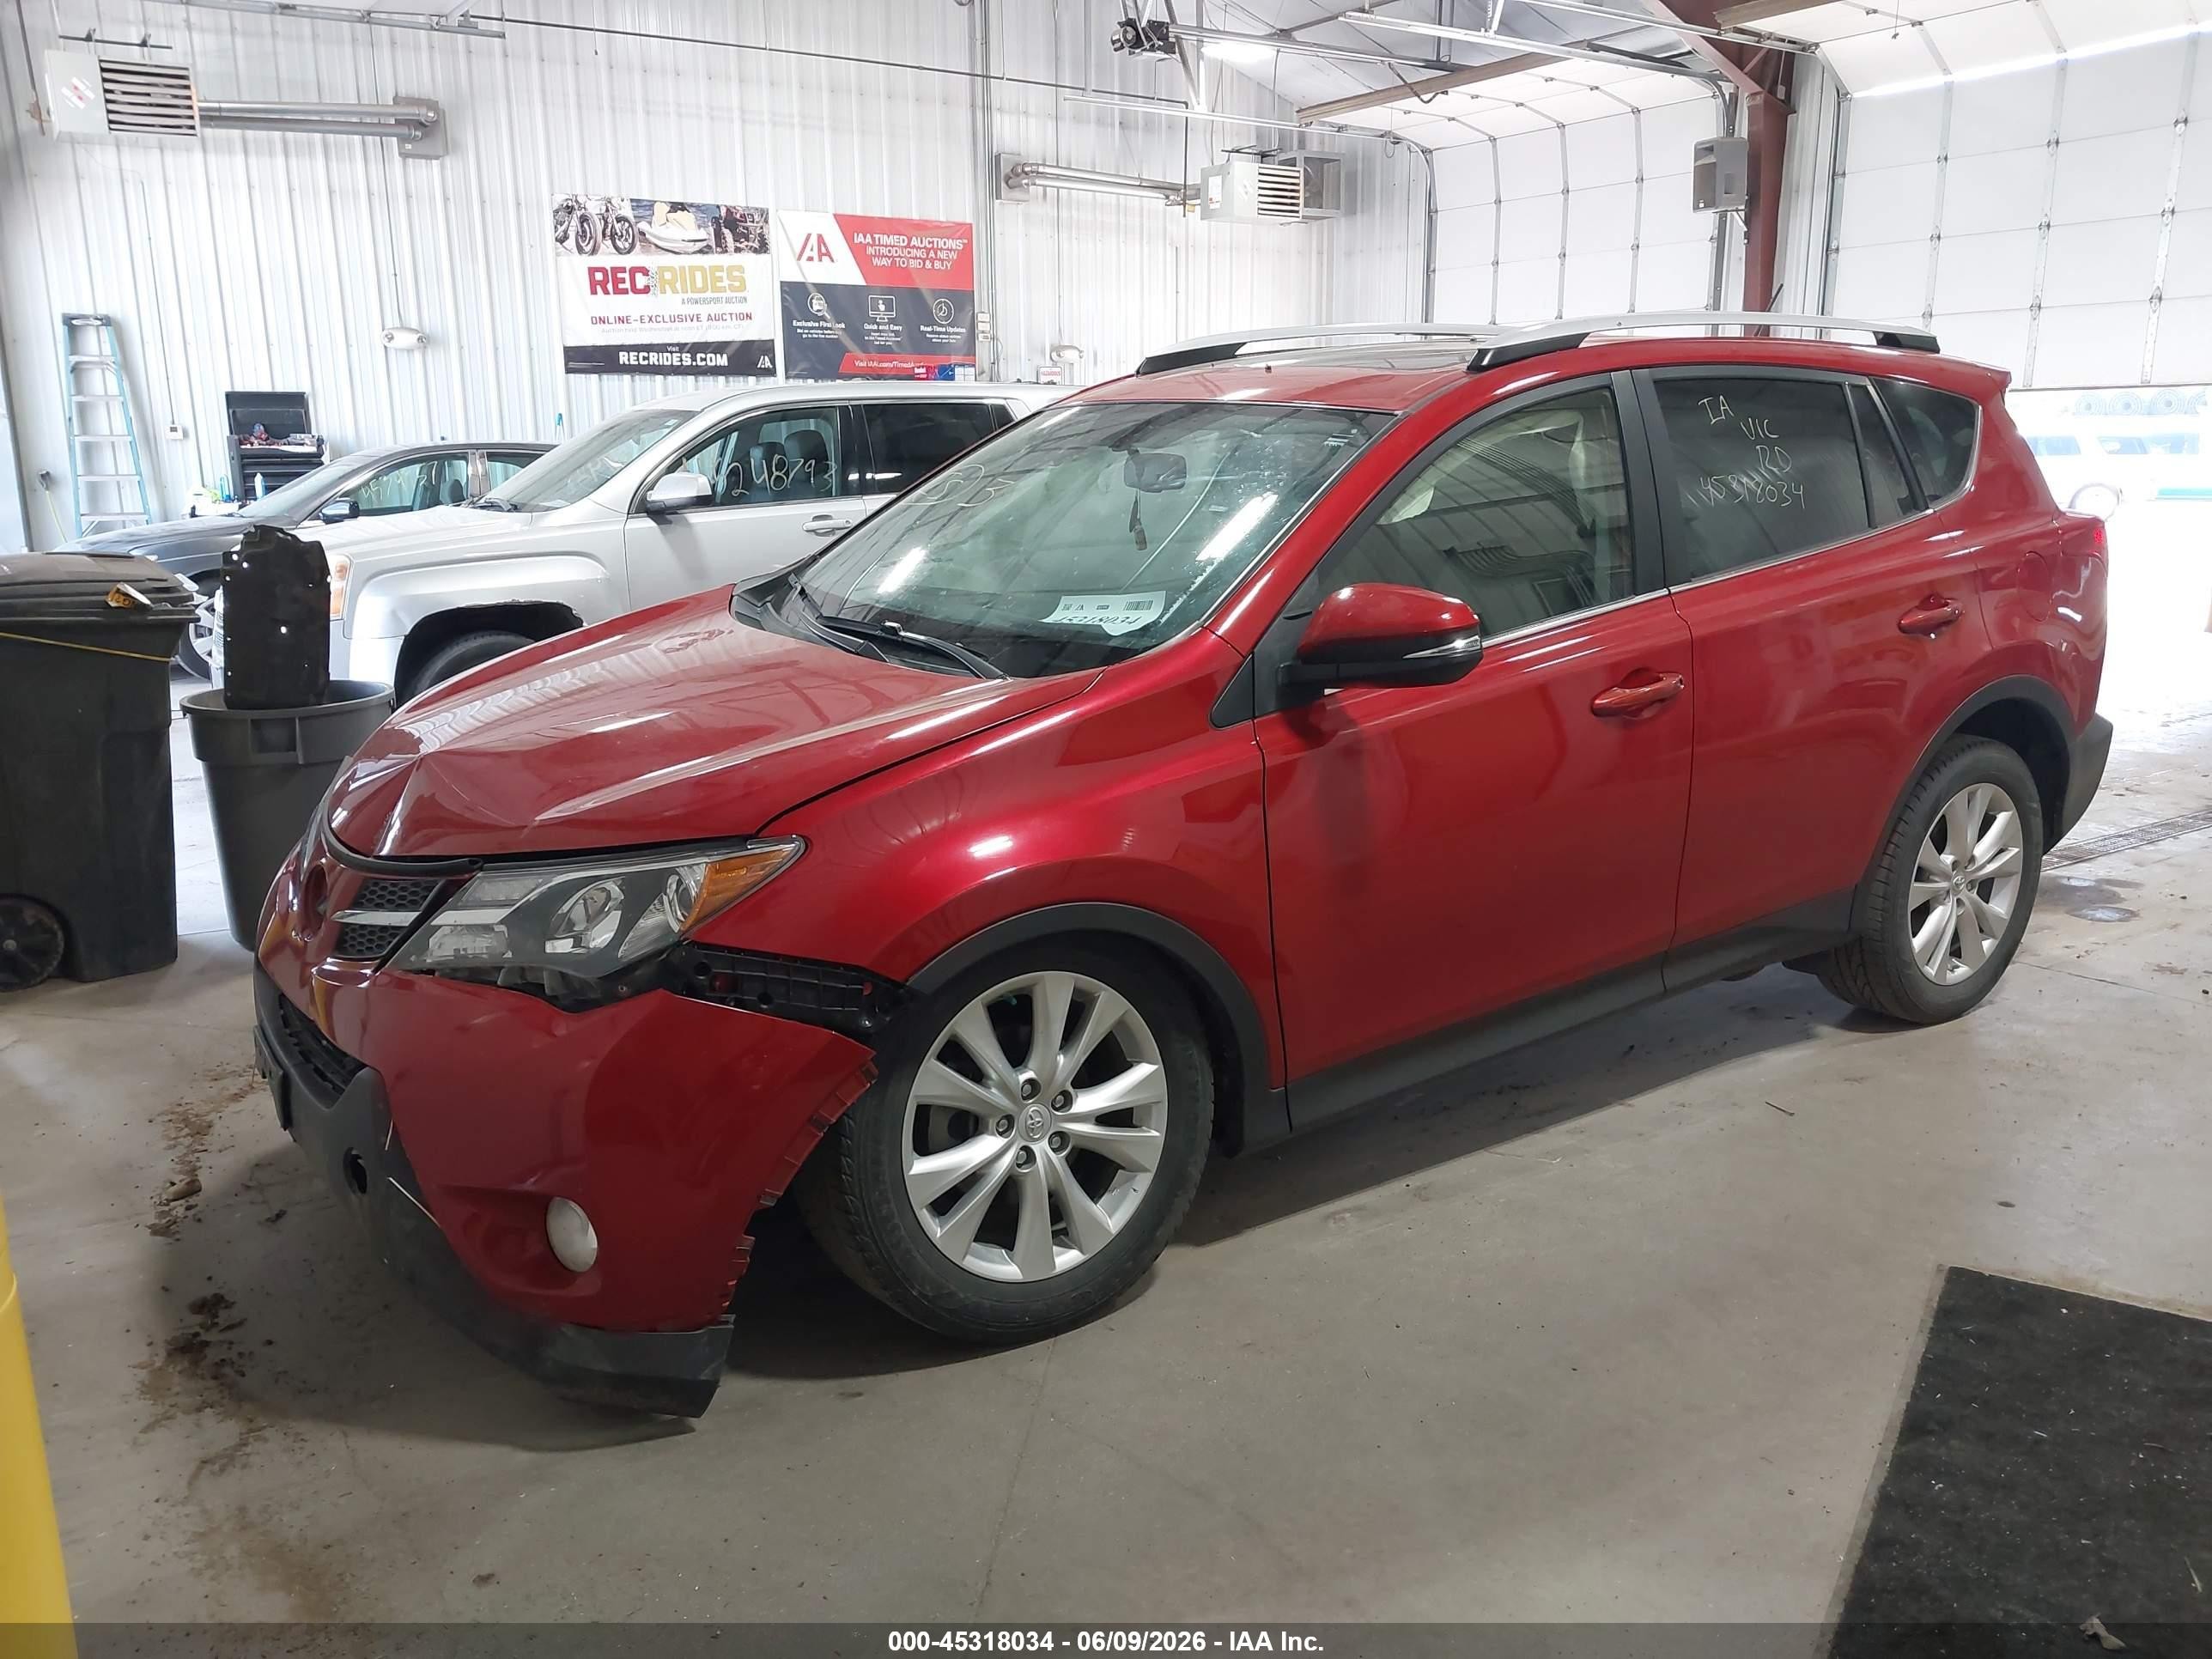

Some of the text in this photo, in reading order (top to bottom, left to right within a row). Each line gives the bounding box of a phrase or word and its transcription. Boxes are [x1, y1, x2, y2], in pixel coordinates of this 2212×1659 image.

[854, 233, 872, 244] IAA
[872, 234, 908, 246] TIMED
[866, 246, 957, 260] INTRODUCING A NEW
[872, 257, 952, 270] WAY TO BID & BUY
[587, 265, 748, 295] REC RIDES
[681, 295, 748, 306] A POWERSPORT AUCTION
[591, 312, 753, 325] ONLINE-EXCLUSIVE AUCTION
[618, 351, 729, 367] RECRIDES.COM
[1698, 395, 1735, 425] IA
[1740, 417, 1780, 441] VIC
